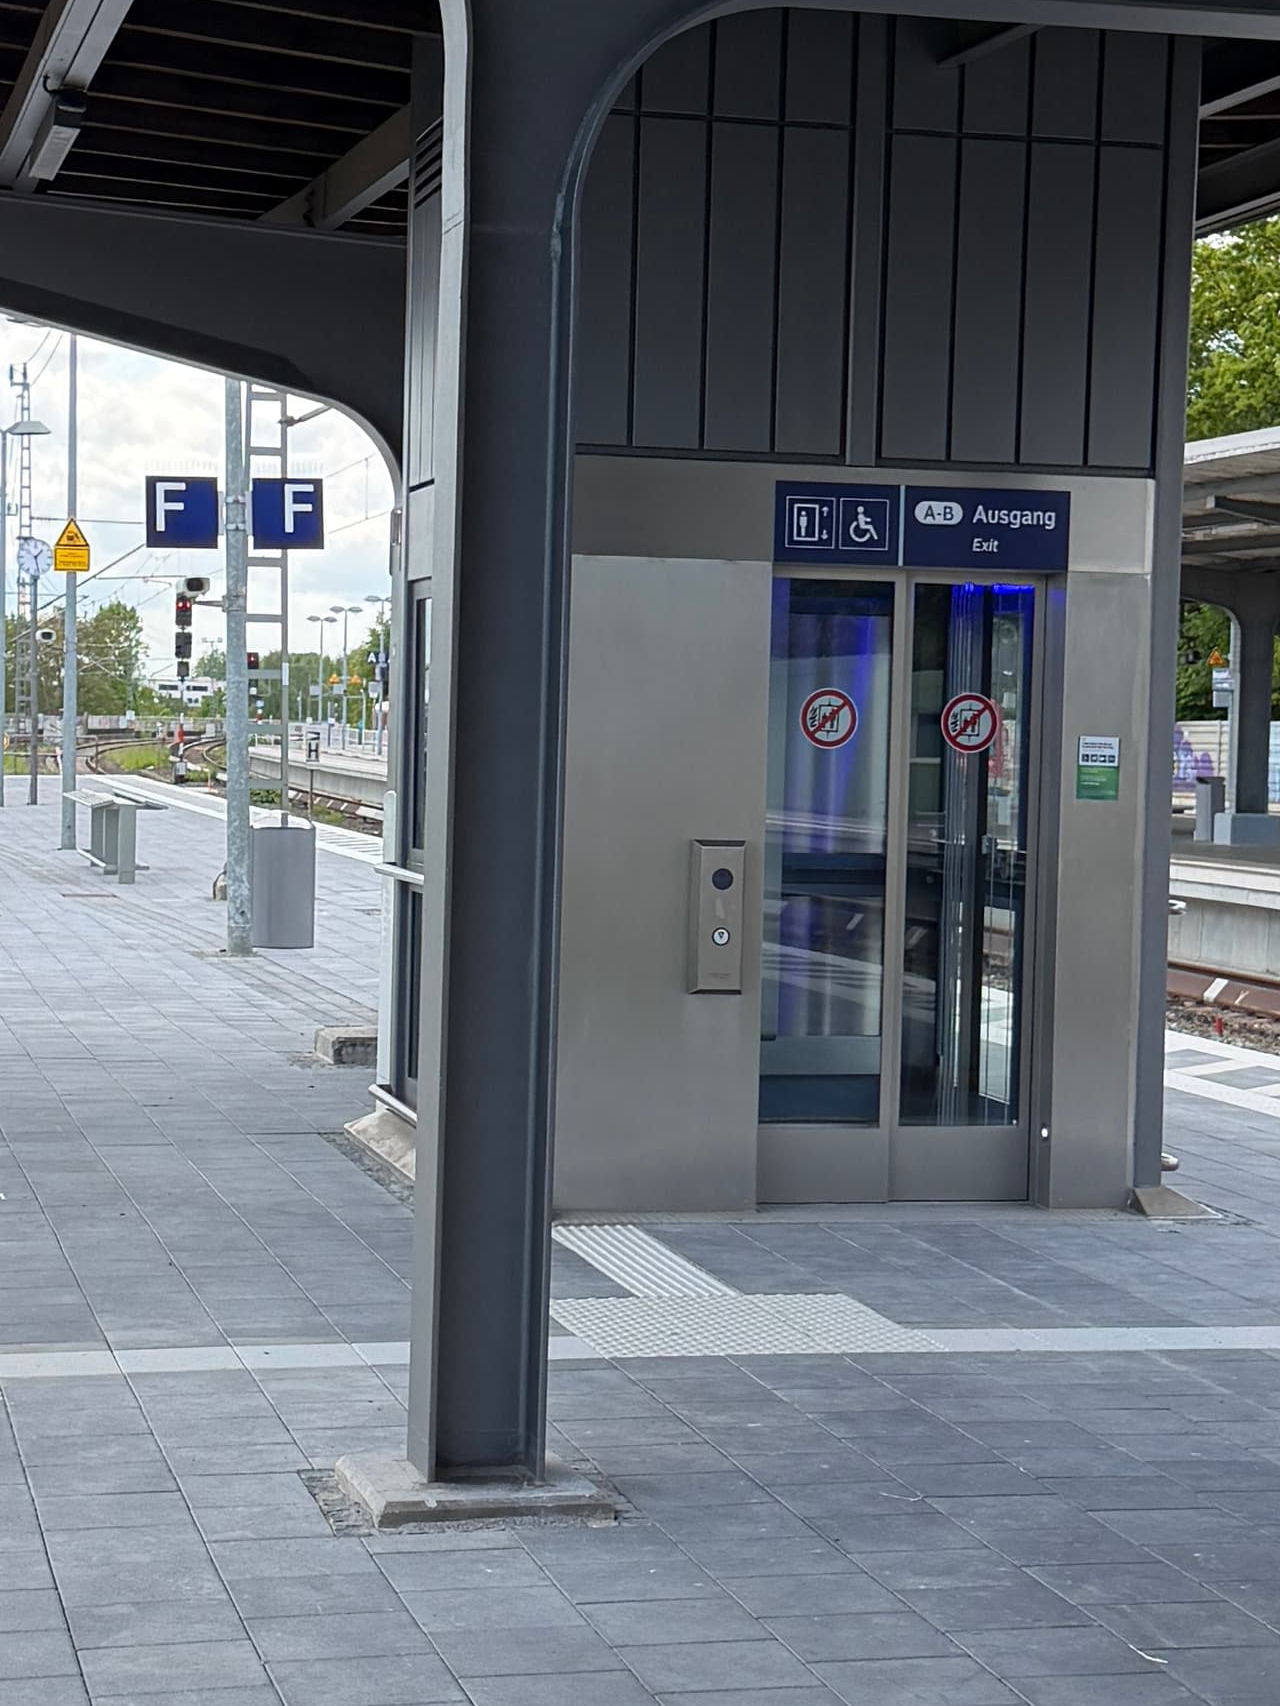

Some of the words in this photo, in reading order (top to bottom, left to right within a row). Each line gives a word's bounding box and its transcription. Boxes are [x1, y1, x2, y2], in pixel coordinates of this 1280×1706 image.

[155, 481, 186, 532] F
[283, 483, 315, 533] F
[923, 504, 954, 522] A-B
[972, 504, 1057, 530] Ausgang
[971, 538, 999, 552] Exit
[307, 741, 319, 760] H
